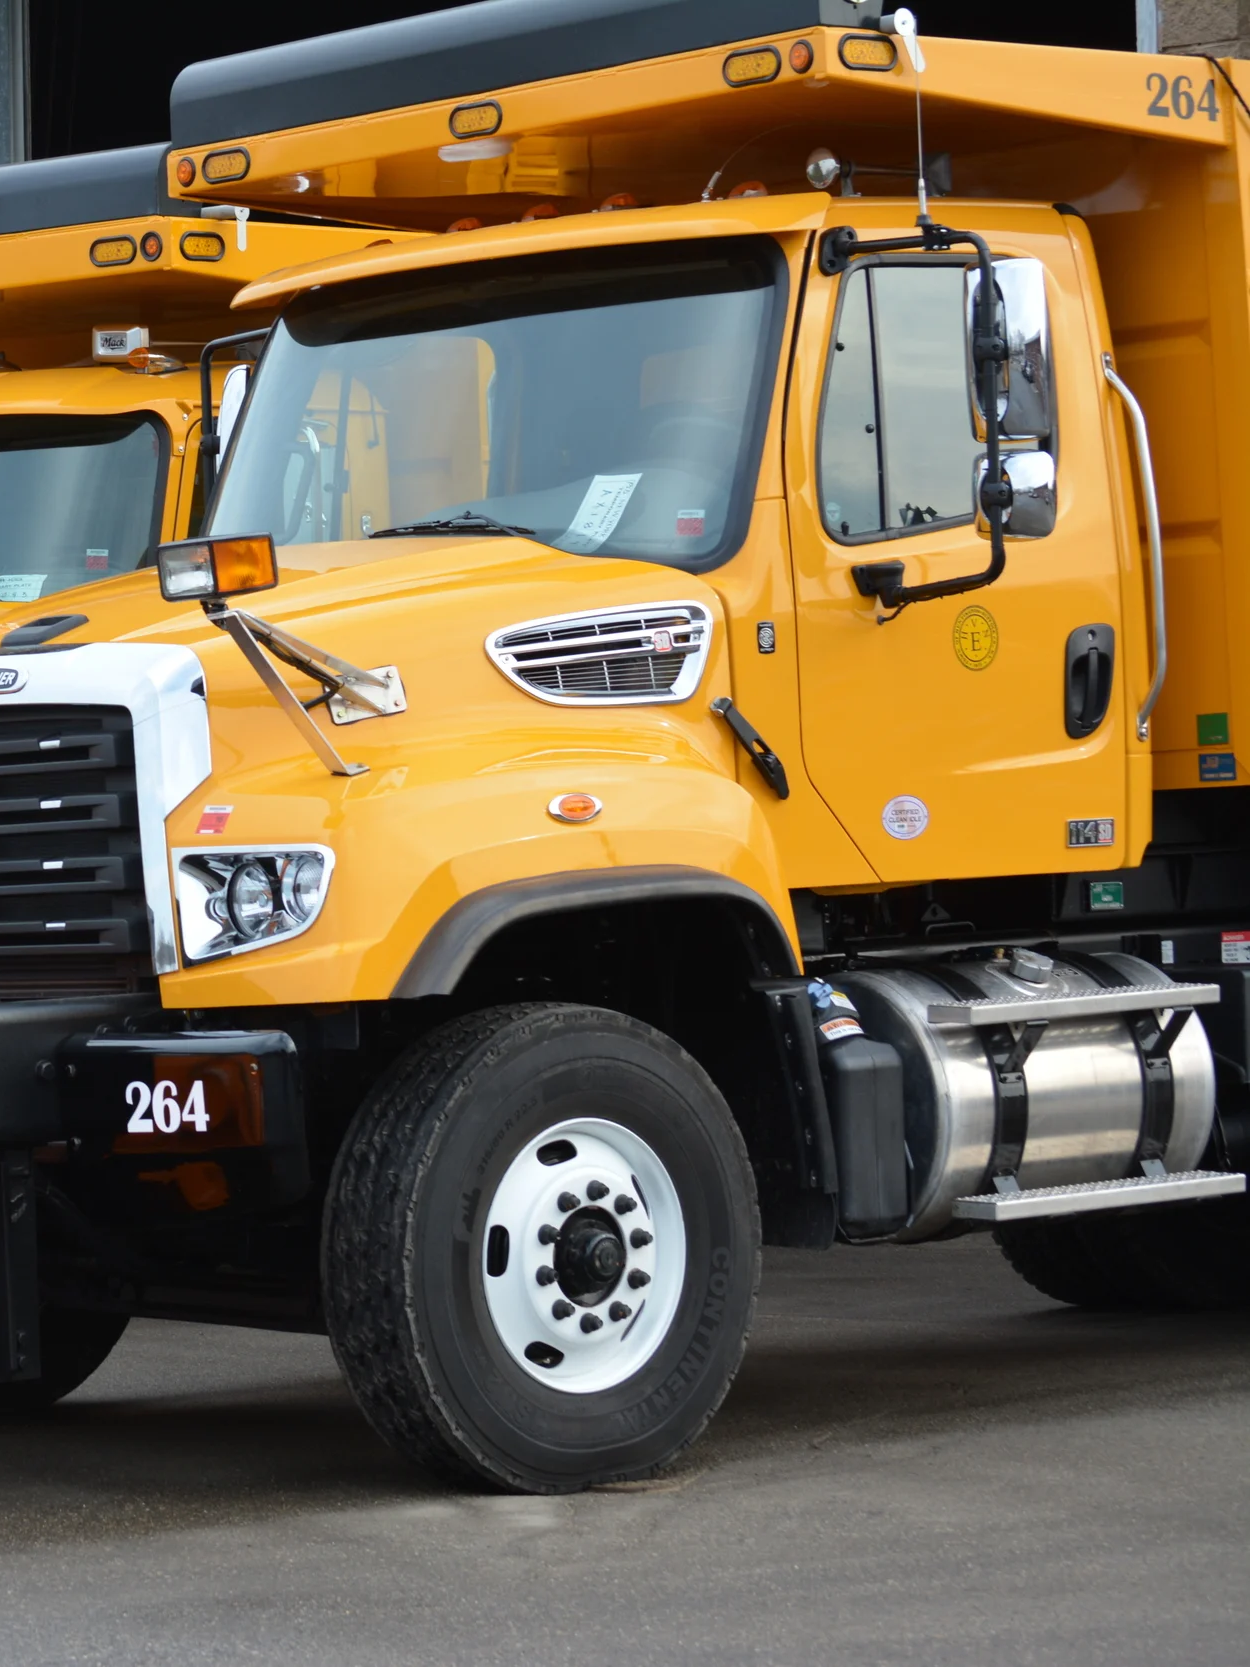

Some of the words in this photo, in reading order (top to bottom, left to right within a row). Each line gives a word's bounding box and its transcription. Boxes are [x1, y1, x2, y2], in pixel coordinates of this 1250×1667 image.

[1146, 72, 1219, 122] 264
[102, 337, 125, 350] Mack
[891, 808, 920, 816] CERTIFIED
[125, 1080, 210, 1133] 264
[608, 1246, 731, 1435] CONTINENTAL
